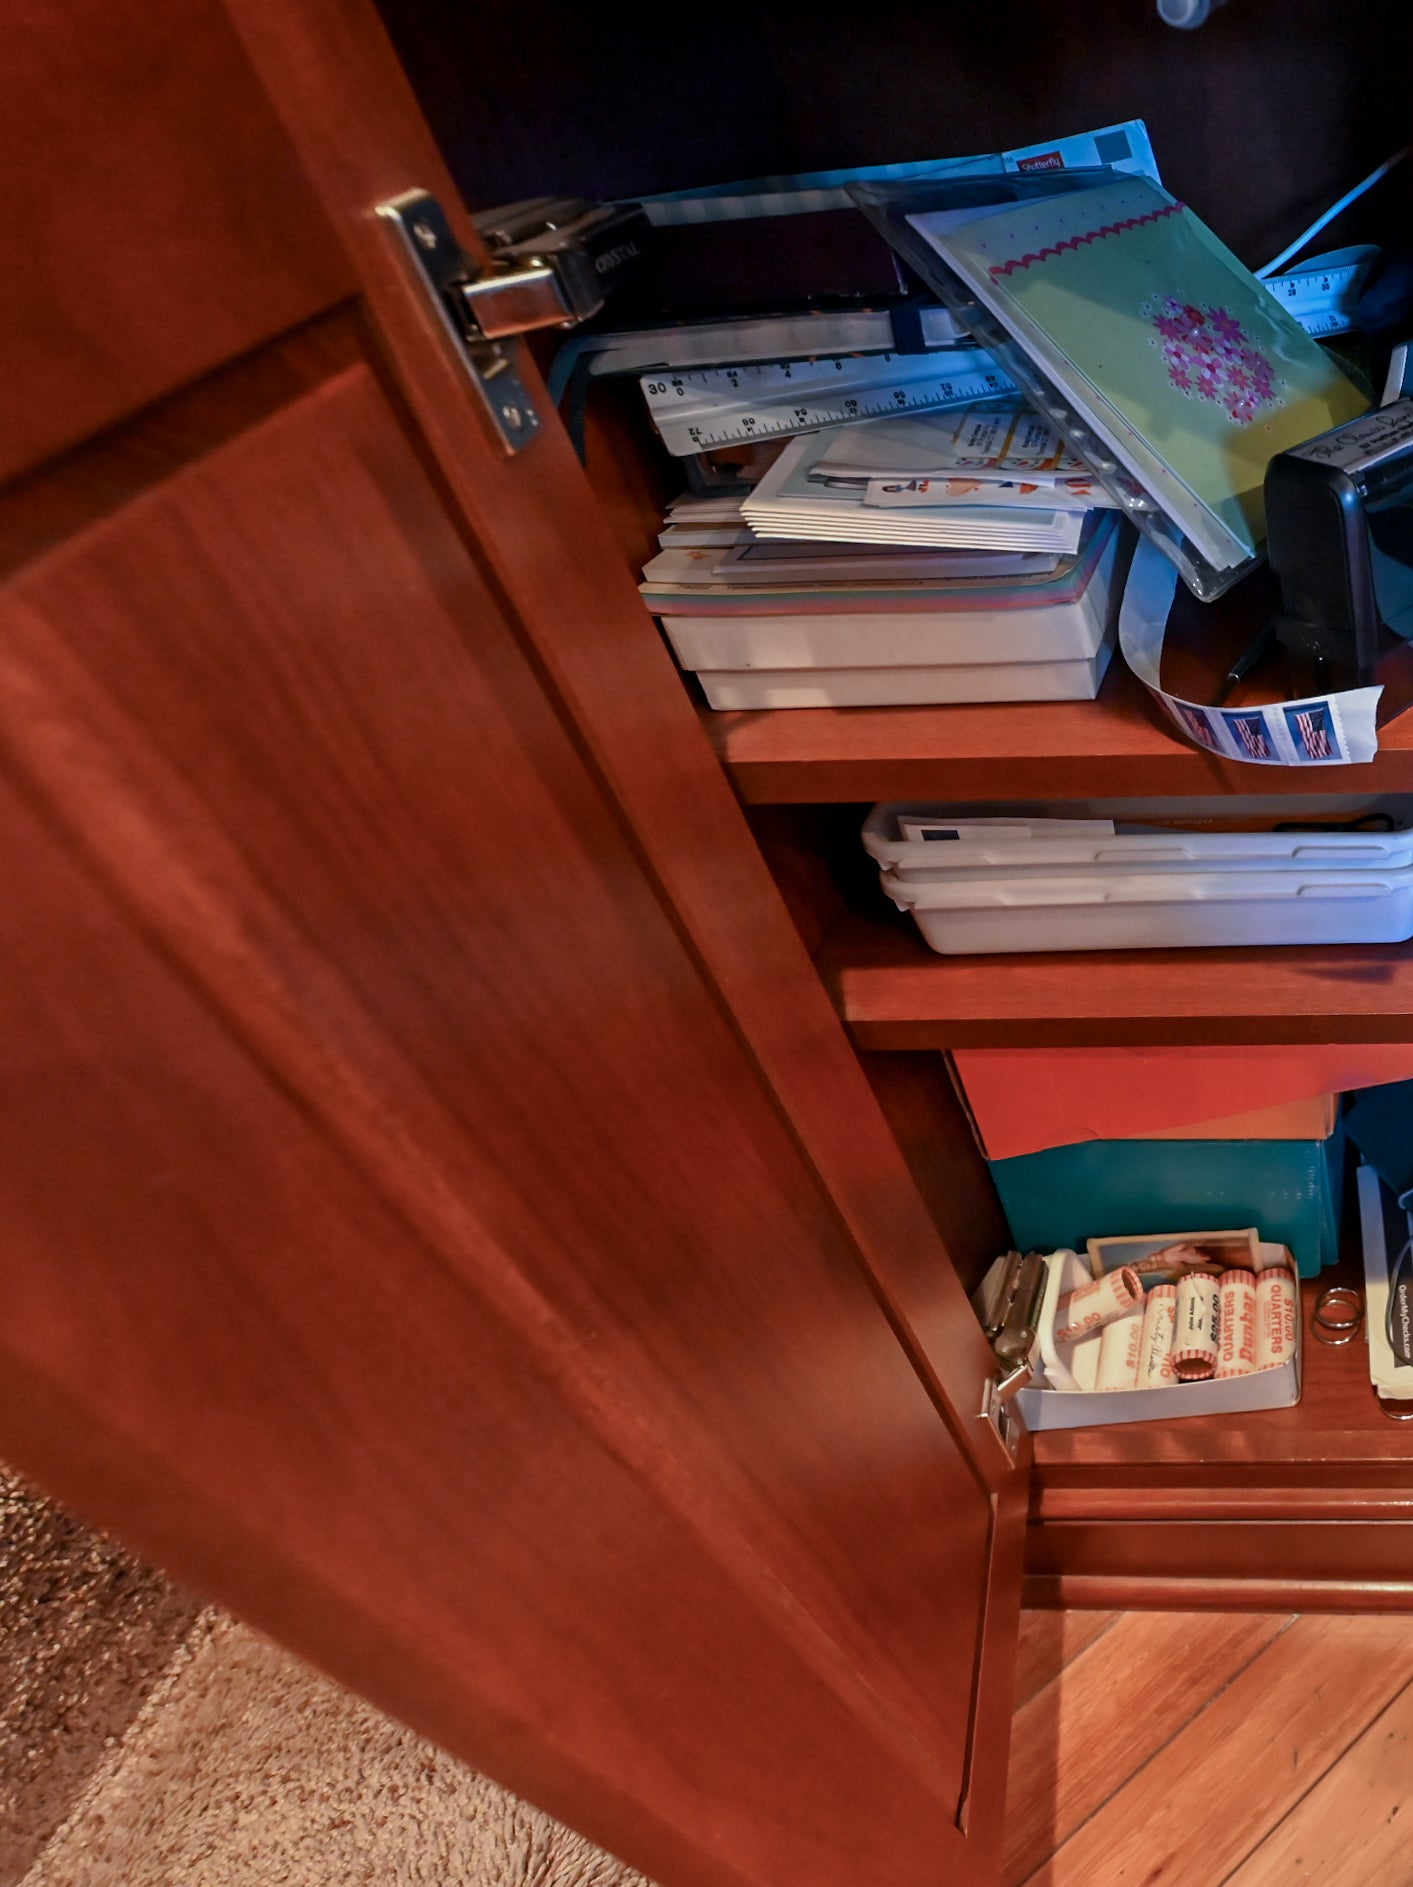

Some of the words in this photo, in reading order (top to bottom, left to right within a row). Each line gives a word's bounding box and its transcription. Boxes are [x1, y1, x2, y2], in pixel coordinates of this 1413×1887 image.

[1022, 157, 1062, 172] Shutterfly
[650, 383, 667, 395] 30
[1223, 1290, 1235, 1362] QUARTERS
[1270, 1283, 1283, 1354] QUARTERS
[1284, 1297, 1296, 1342] $10.00
[1399, 1284, 1412, 1360] OrderMyChecks.com
[1126, 1323, 1140, 1369] $10.00
